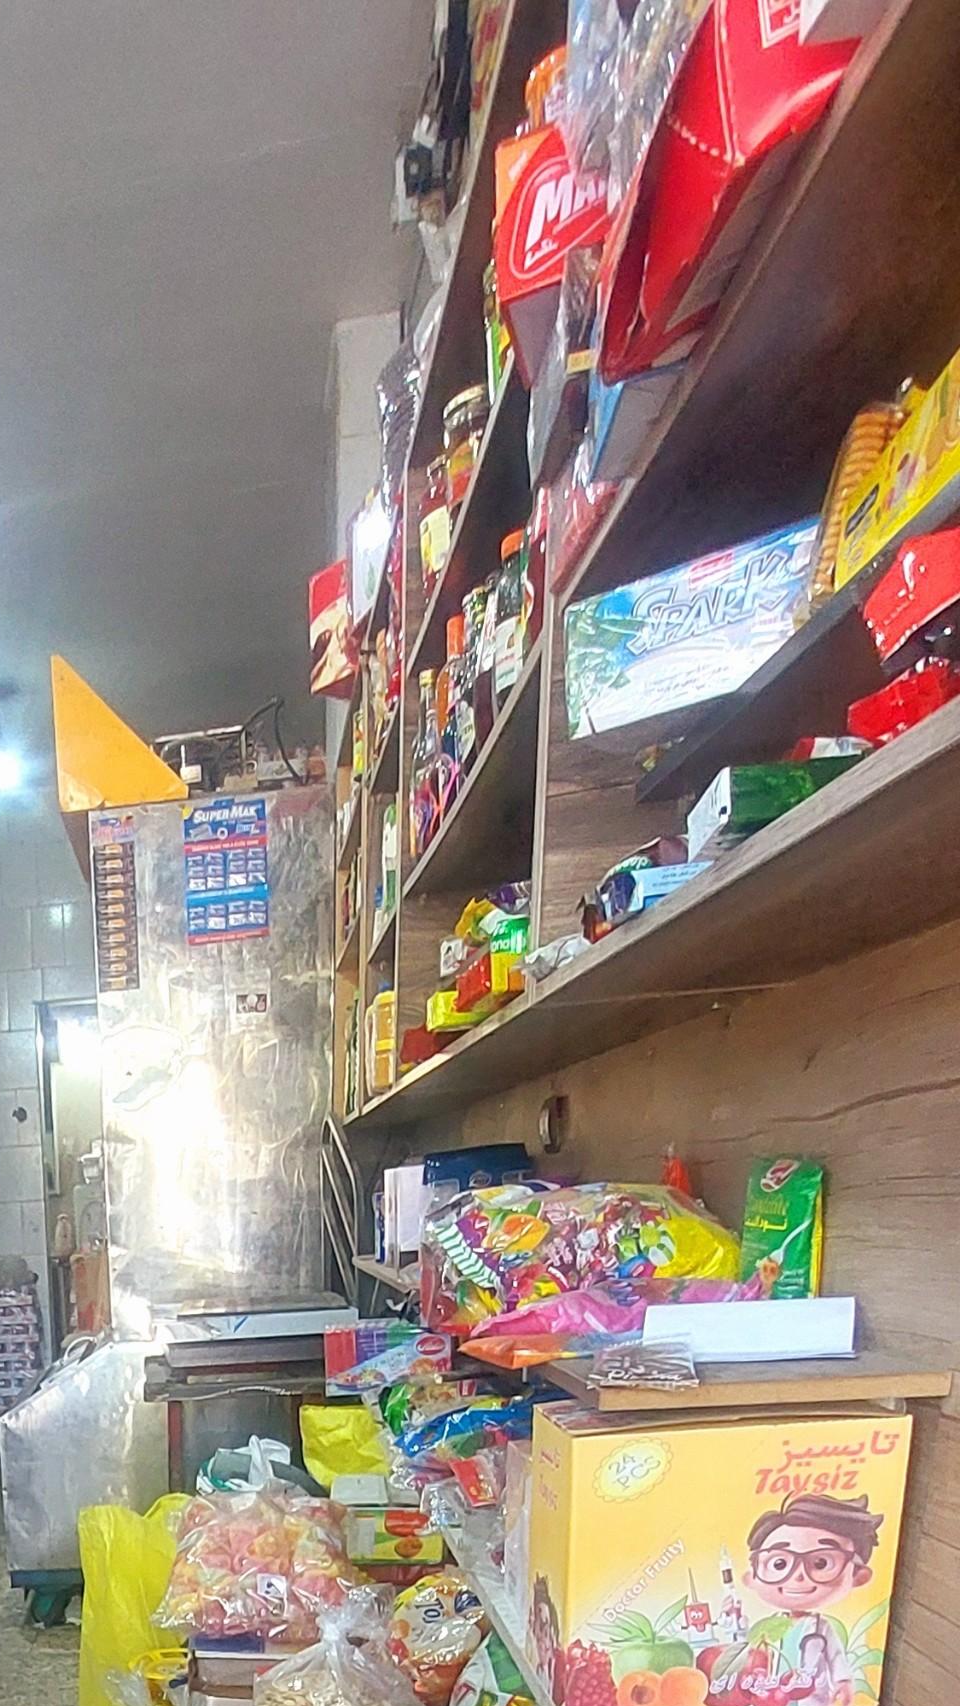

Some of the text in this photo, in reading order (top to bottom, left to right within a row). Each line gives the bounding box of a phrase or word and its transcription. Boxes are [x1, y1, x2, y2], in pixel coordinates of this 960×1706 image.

[626, 553, 789, 655] SPARK
[193, 808, 231, 824] SUPER
[607, 1452, 637, 1475] 24
[776, 1430, 901, 1473] تایسیز
[615, 1454, 664, 1491] PCS
[755, 1464, 861, 1497] Taysiz
[603, 1538, 686, 1623] Doctor Fruity
